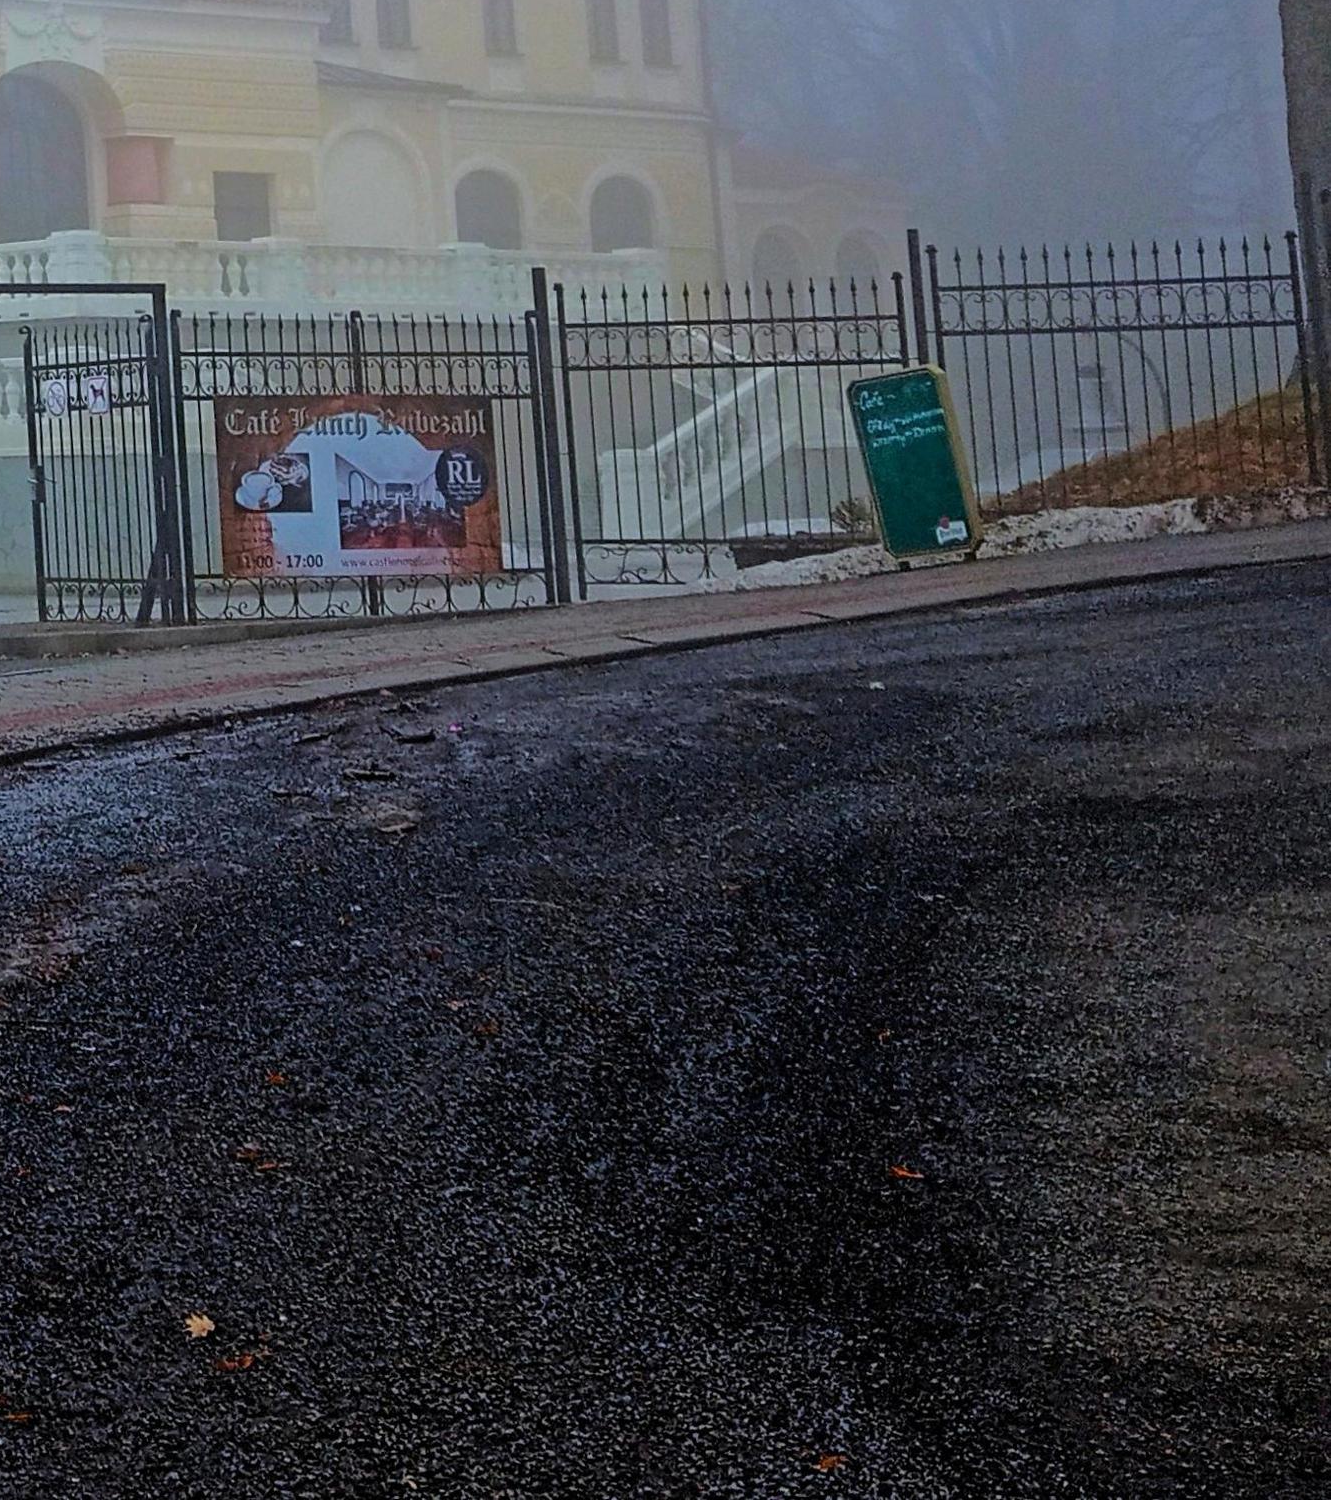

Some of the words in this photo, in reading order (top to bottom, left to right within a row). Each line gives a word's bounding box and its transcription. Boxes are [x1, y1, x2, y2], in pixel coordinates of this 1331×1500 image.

[225, 408, 282, 435] Café
[288, 407, 368, 440] Lunch
[447, 460, 482, 485] RL
[286, 554, 324, 569] 17:00
